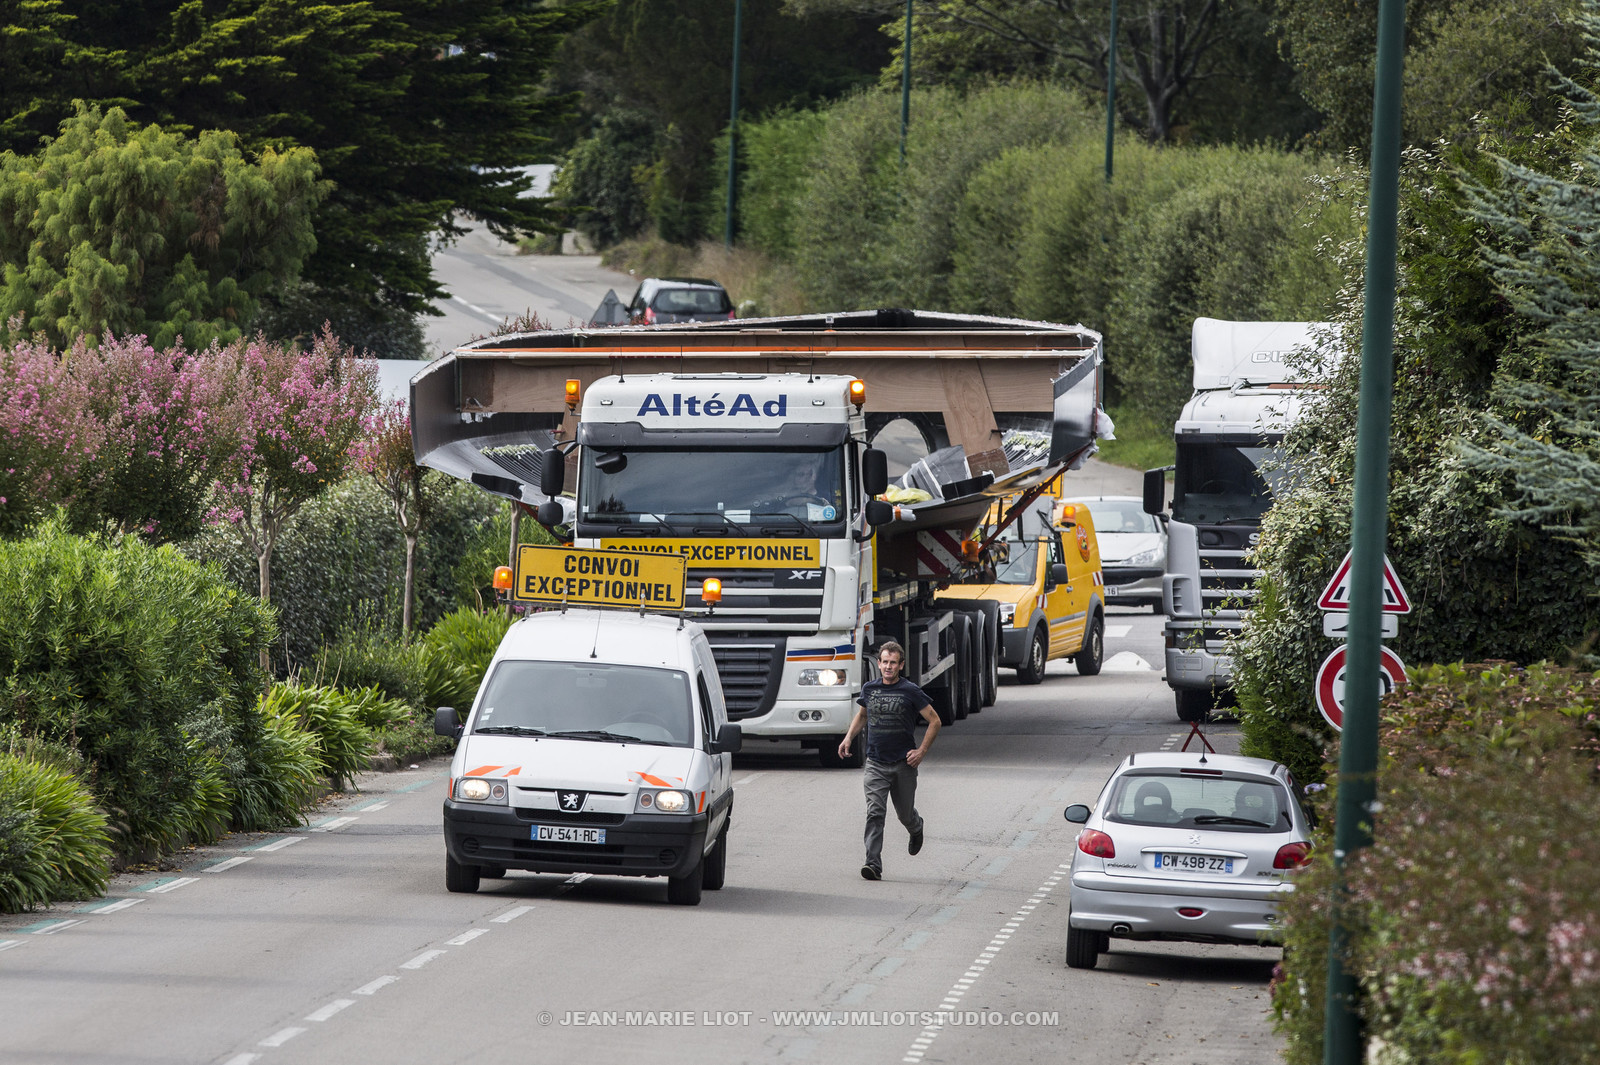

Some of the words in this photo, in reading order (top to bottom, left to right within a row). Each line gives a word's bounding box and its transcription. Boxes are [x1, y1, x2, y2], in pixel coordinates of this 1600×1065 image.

[636, 392, 788, 418] AltéAd
[825, 510, 833, 519] 5
[564, 554, 640, 577] CONVOI
[788, 570, 823, 580] XF
[525, 575, 676, 602] EXCEPTIONNEL
[540, 827, 597, 842] CV-541-RC
[1162, 854, 1225, 871] CW-498-ZZ
